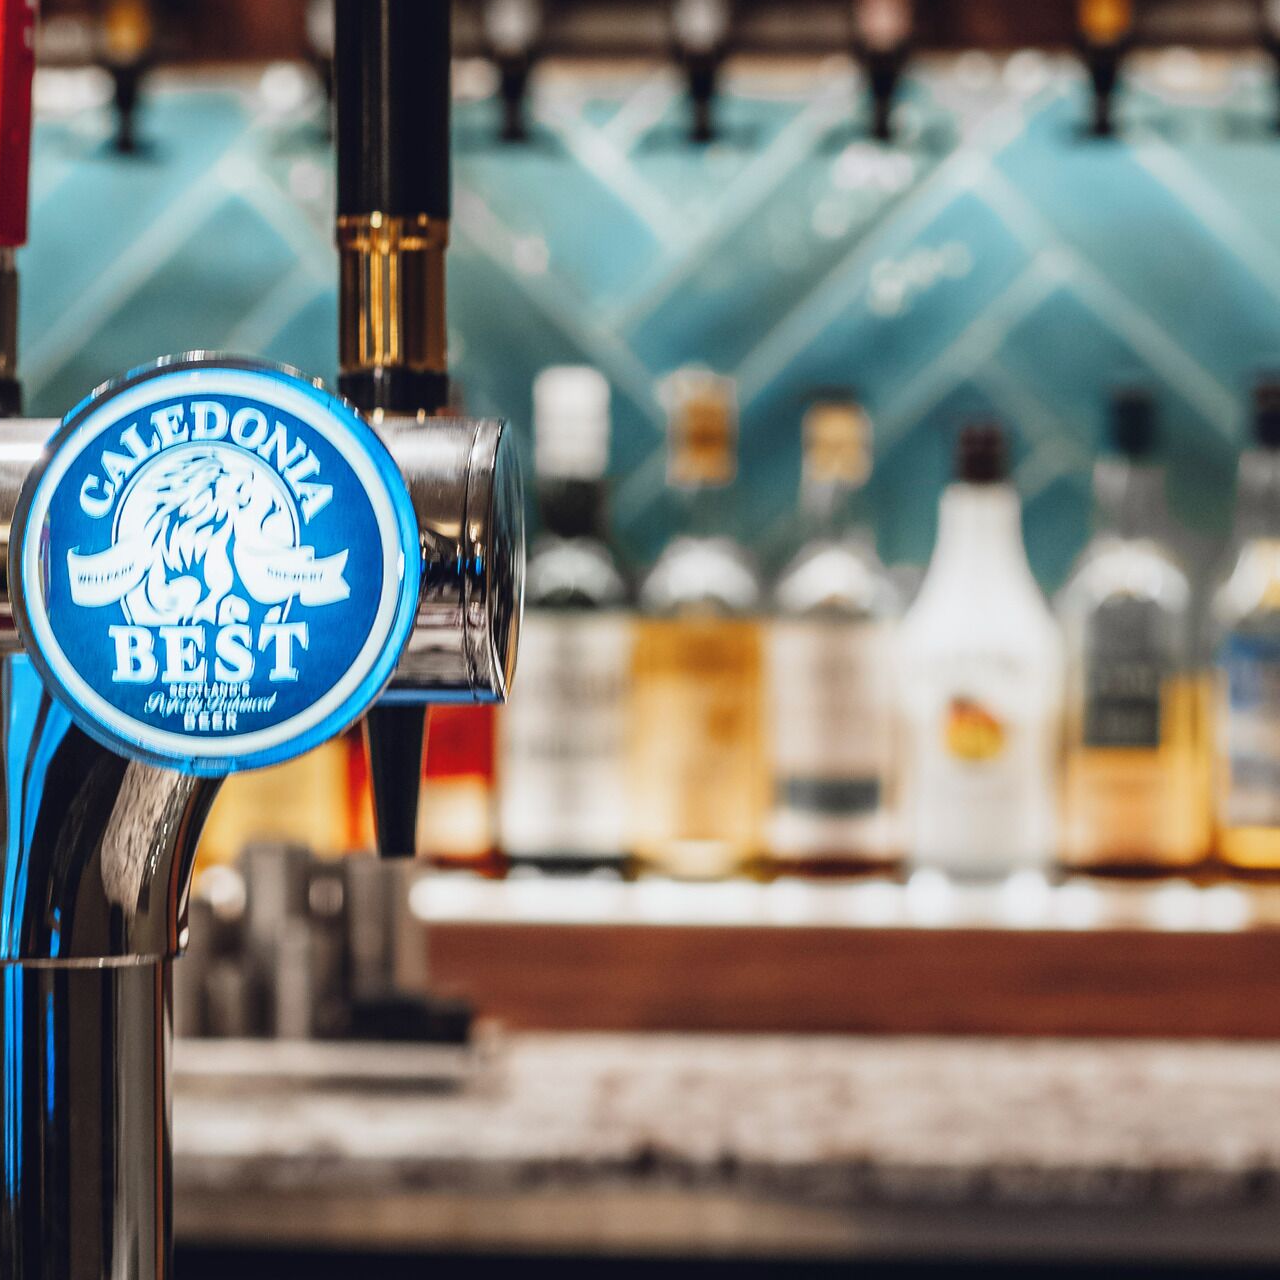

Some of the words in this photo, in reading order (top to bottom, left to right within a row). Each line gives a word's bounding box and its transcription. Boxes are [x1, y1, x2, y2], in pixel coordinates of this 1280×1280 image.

[79, 400, 334, 526] CALEDONIA
[108, 622, 309, 684] BEST
[183, 710, 238, 732] BEER
